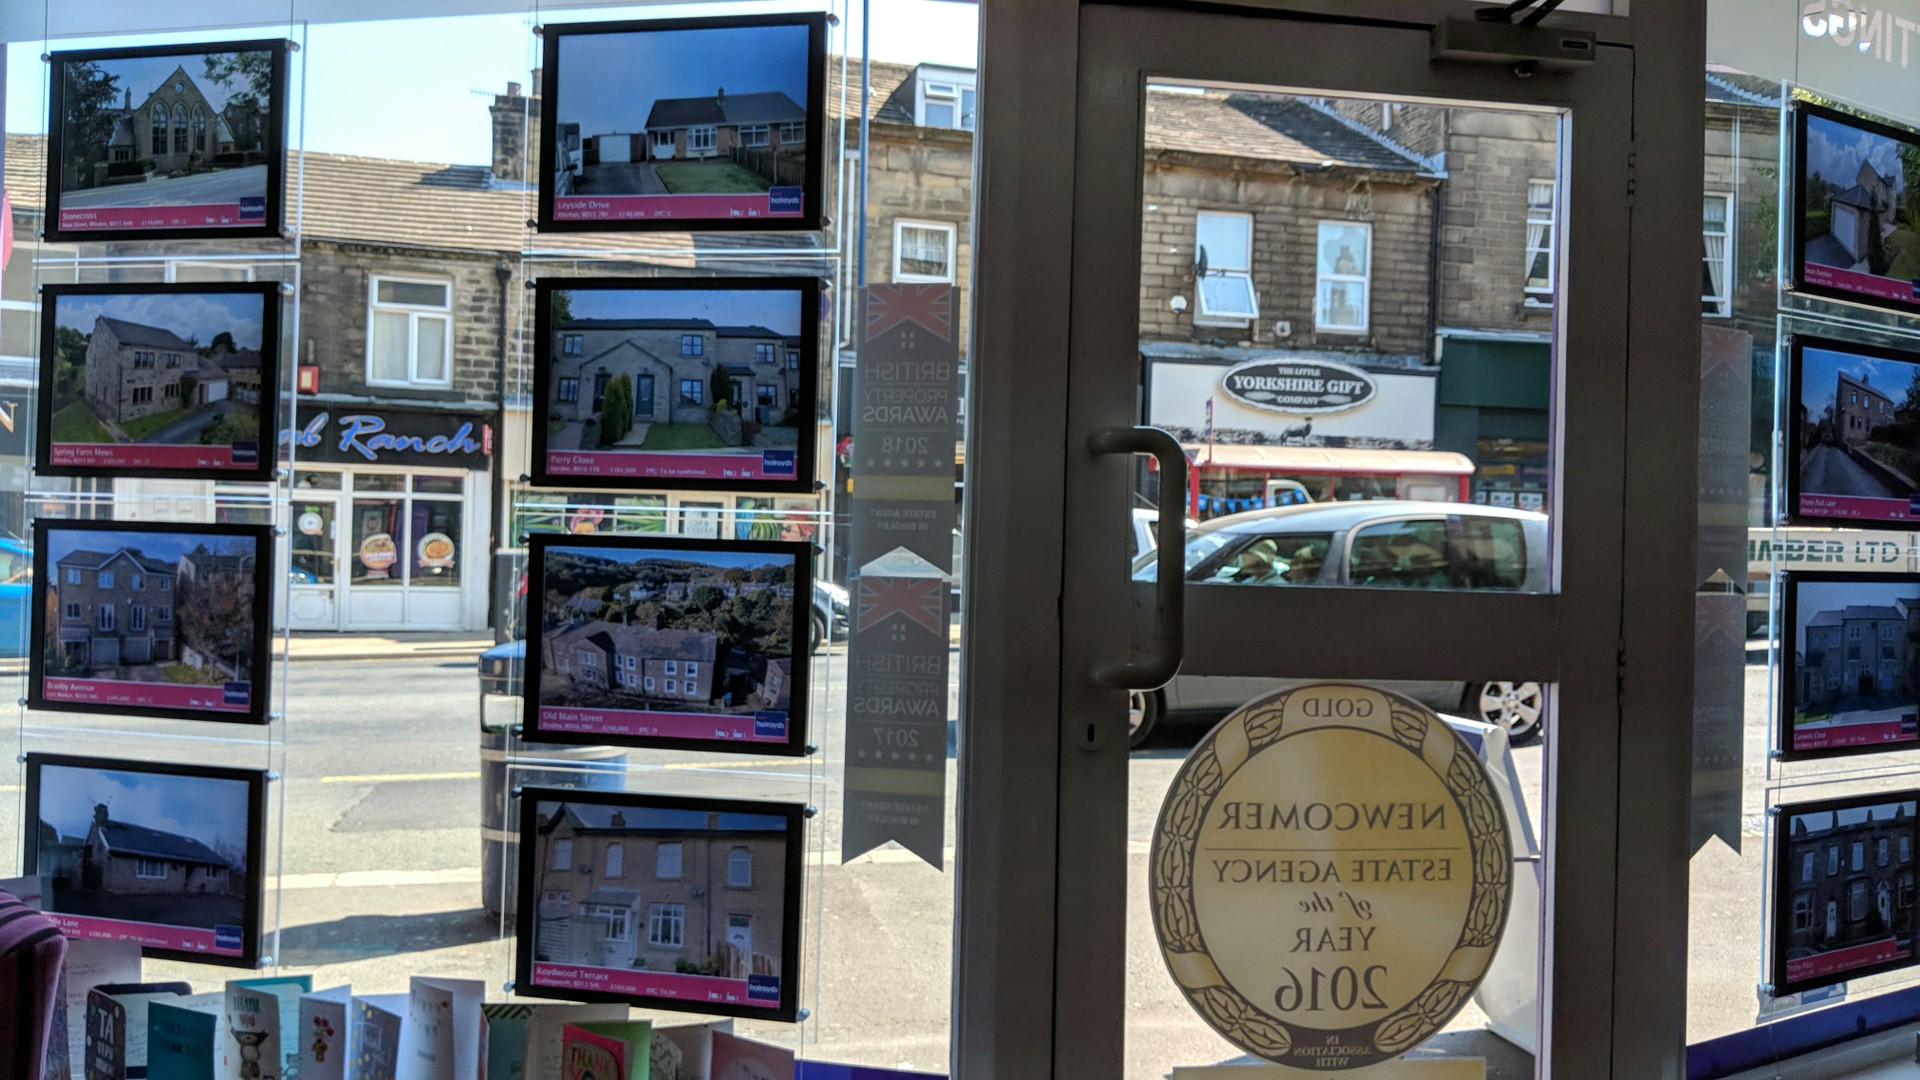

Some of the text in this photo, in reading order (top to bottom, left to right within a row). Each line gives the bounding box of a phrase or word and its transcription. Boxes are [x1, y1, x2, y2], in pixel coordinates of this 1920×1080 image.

[557, 201, 610, 210] Leyside Drive
[62, 213, 97, 221] Stonecross
[1277, 367, 1322, 376] THE LITTLE
[1233, 375, 1365, 395] YORKSHIRE GIFT
[1276, 395, 1319, 406] COMPANY
[338, 414, 481, 460] Ranch
[551, 455, 595, 465] Parry Close
[764, 458, 793, 468] holroyds
[1854, 540, 1901, 563] LTD
[70, 683, 96, 692] Avenue
[543, 711, 603, 722] Old Main Street
[756, 719, 785, 730] holroyds
[536, 966, 609, 981] Roydwood Terrace
[749, 983, 778, 994] holroyds
[97, 1008, 114, 1044] TA
